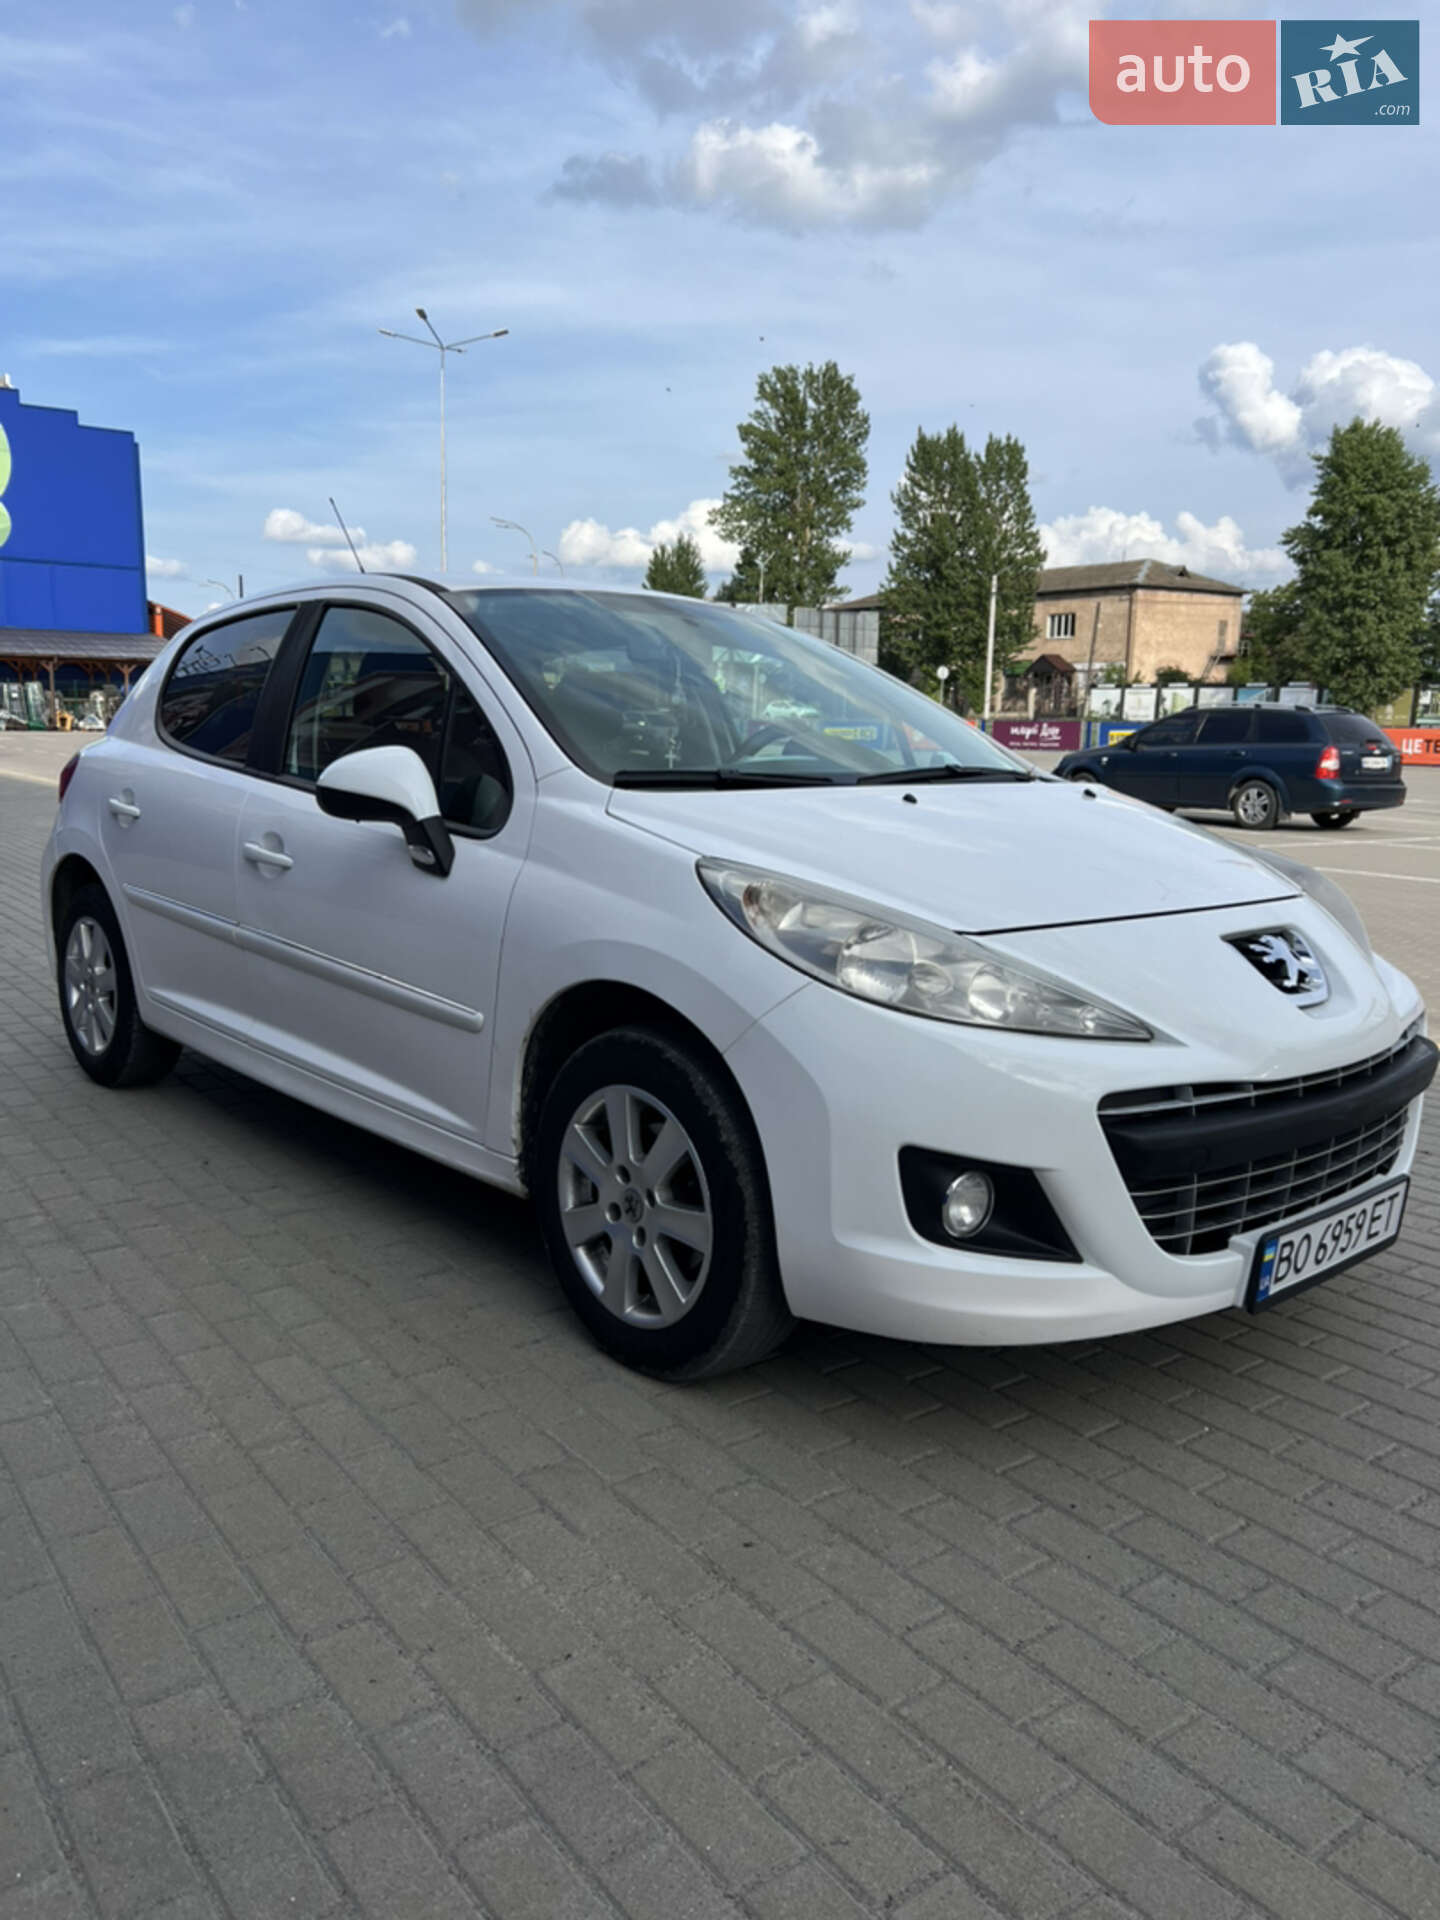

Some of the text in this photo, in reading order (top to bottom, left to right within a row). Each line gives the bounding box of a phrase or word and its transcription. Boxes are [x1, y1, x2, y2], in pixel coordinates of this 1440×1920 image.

[1273, 1191, 1400, 1284] BO 6959 ET
